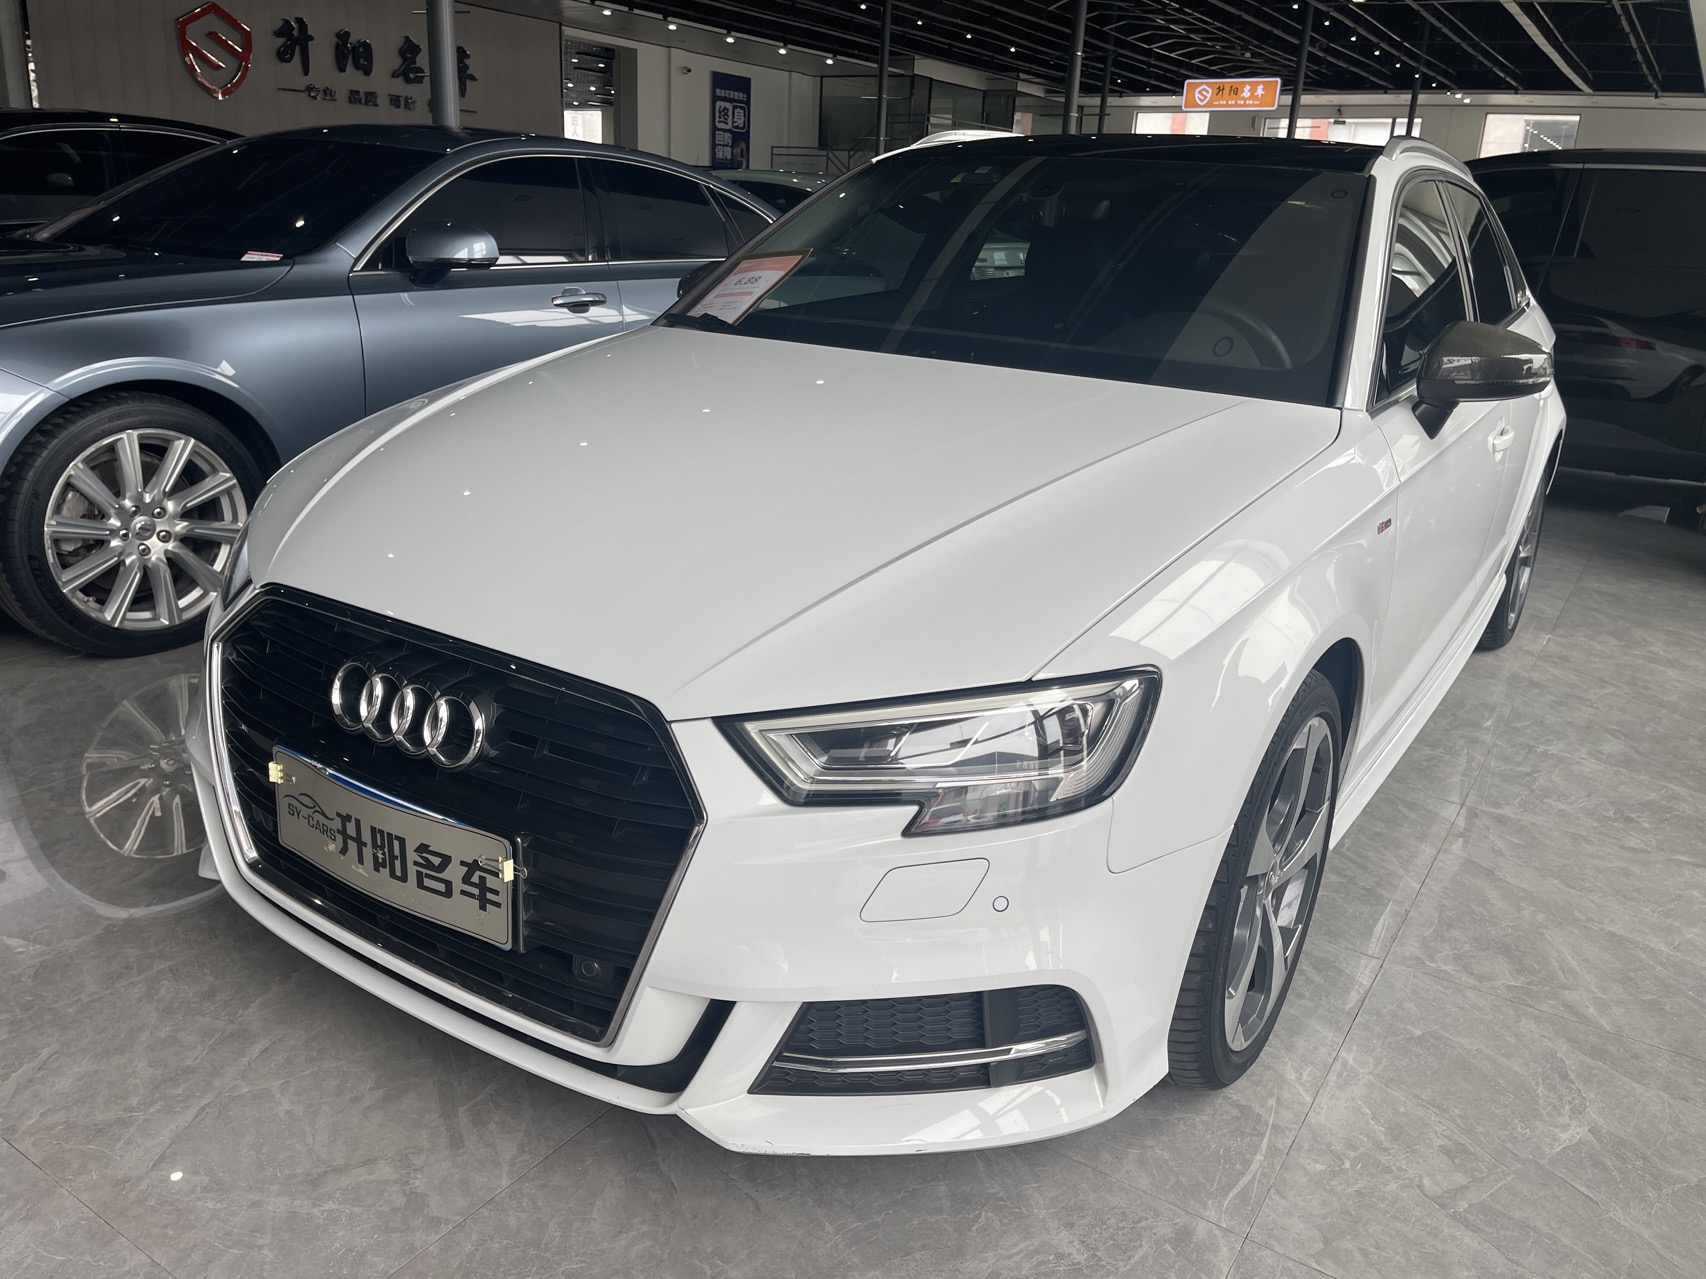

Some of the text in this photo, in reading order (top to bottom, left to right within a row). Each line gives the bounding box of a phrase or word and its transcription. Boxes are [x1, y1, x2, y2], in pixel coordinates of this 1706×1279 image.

[1215, 83, 1265, 99] 升阳名车
[717, 105, 745, 128] 终身
[287, 803, 336, 843] SY-CARS
[336, 812, 503, 912] 升阳名车
